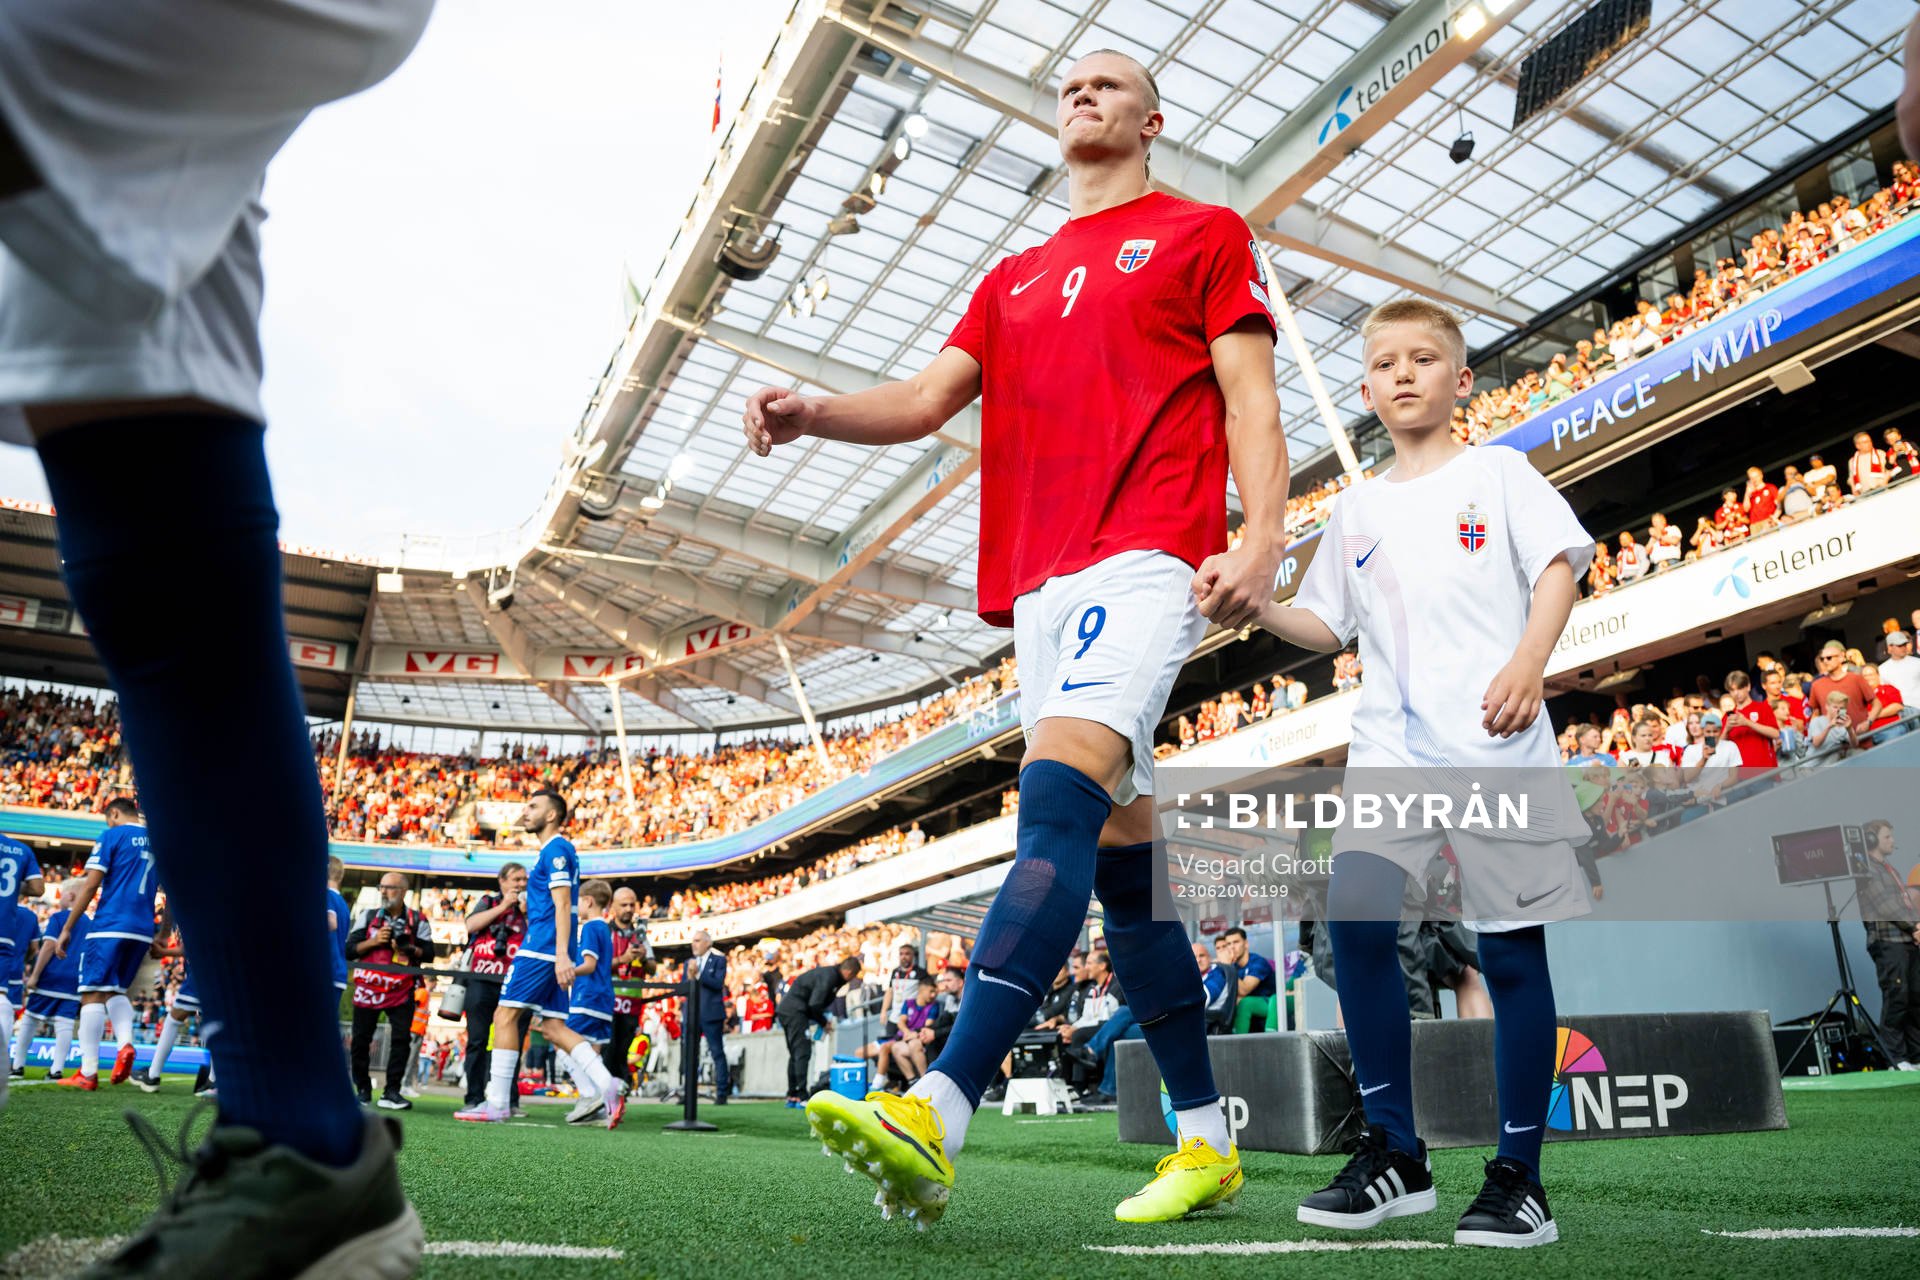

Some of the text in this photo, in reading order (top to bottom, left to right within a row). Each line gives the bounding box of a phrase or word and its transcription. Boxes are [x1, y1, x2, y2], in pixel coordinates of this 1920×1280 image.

[1356, 11, 1461, 112] telenor
[1061, 266, 1087, 318] 9
[1551, 373, 1656, 451] PEACE
[1751, 529, 1857, 583] telenor
[686, 624, 750, 654] VG
[1074, 605, 1106, 660] 9
[1553, 612, 1629, 655] elenor
[406, 652, 498, 674] VG
[138, 850, 156, 894] 7
[1803, 848, 1825, 860] VAR
[1571, 1074, 1689, 1131] NEP
